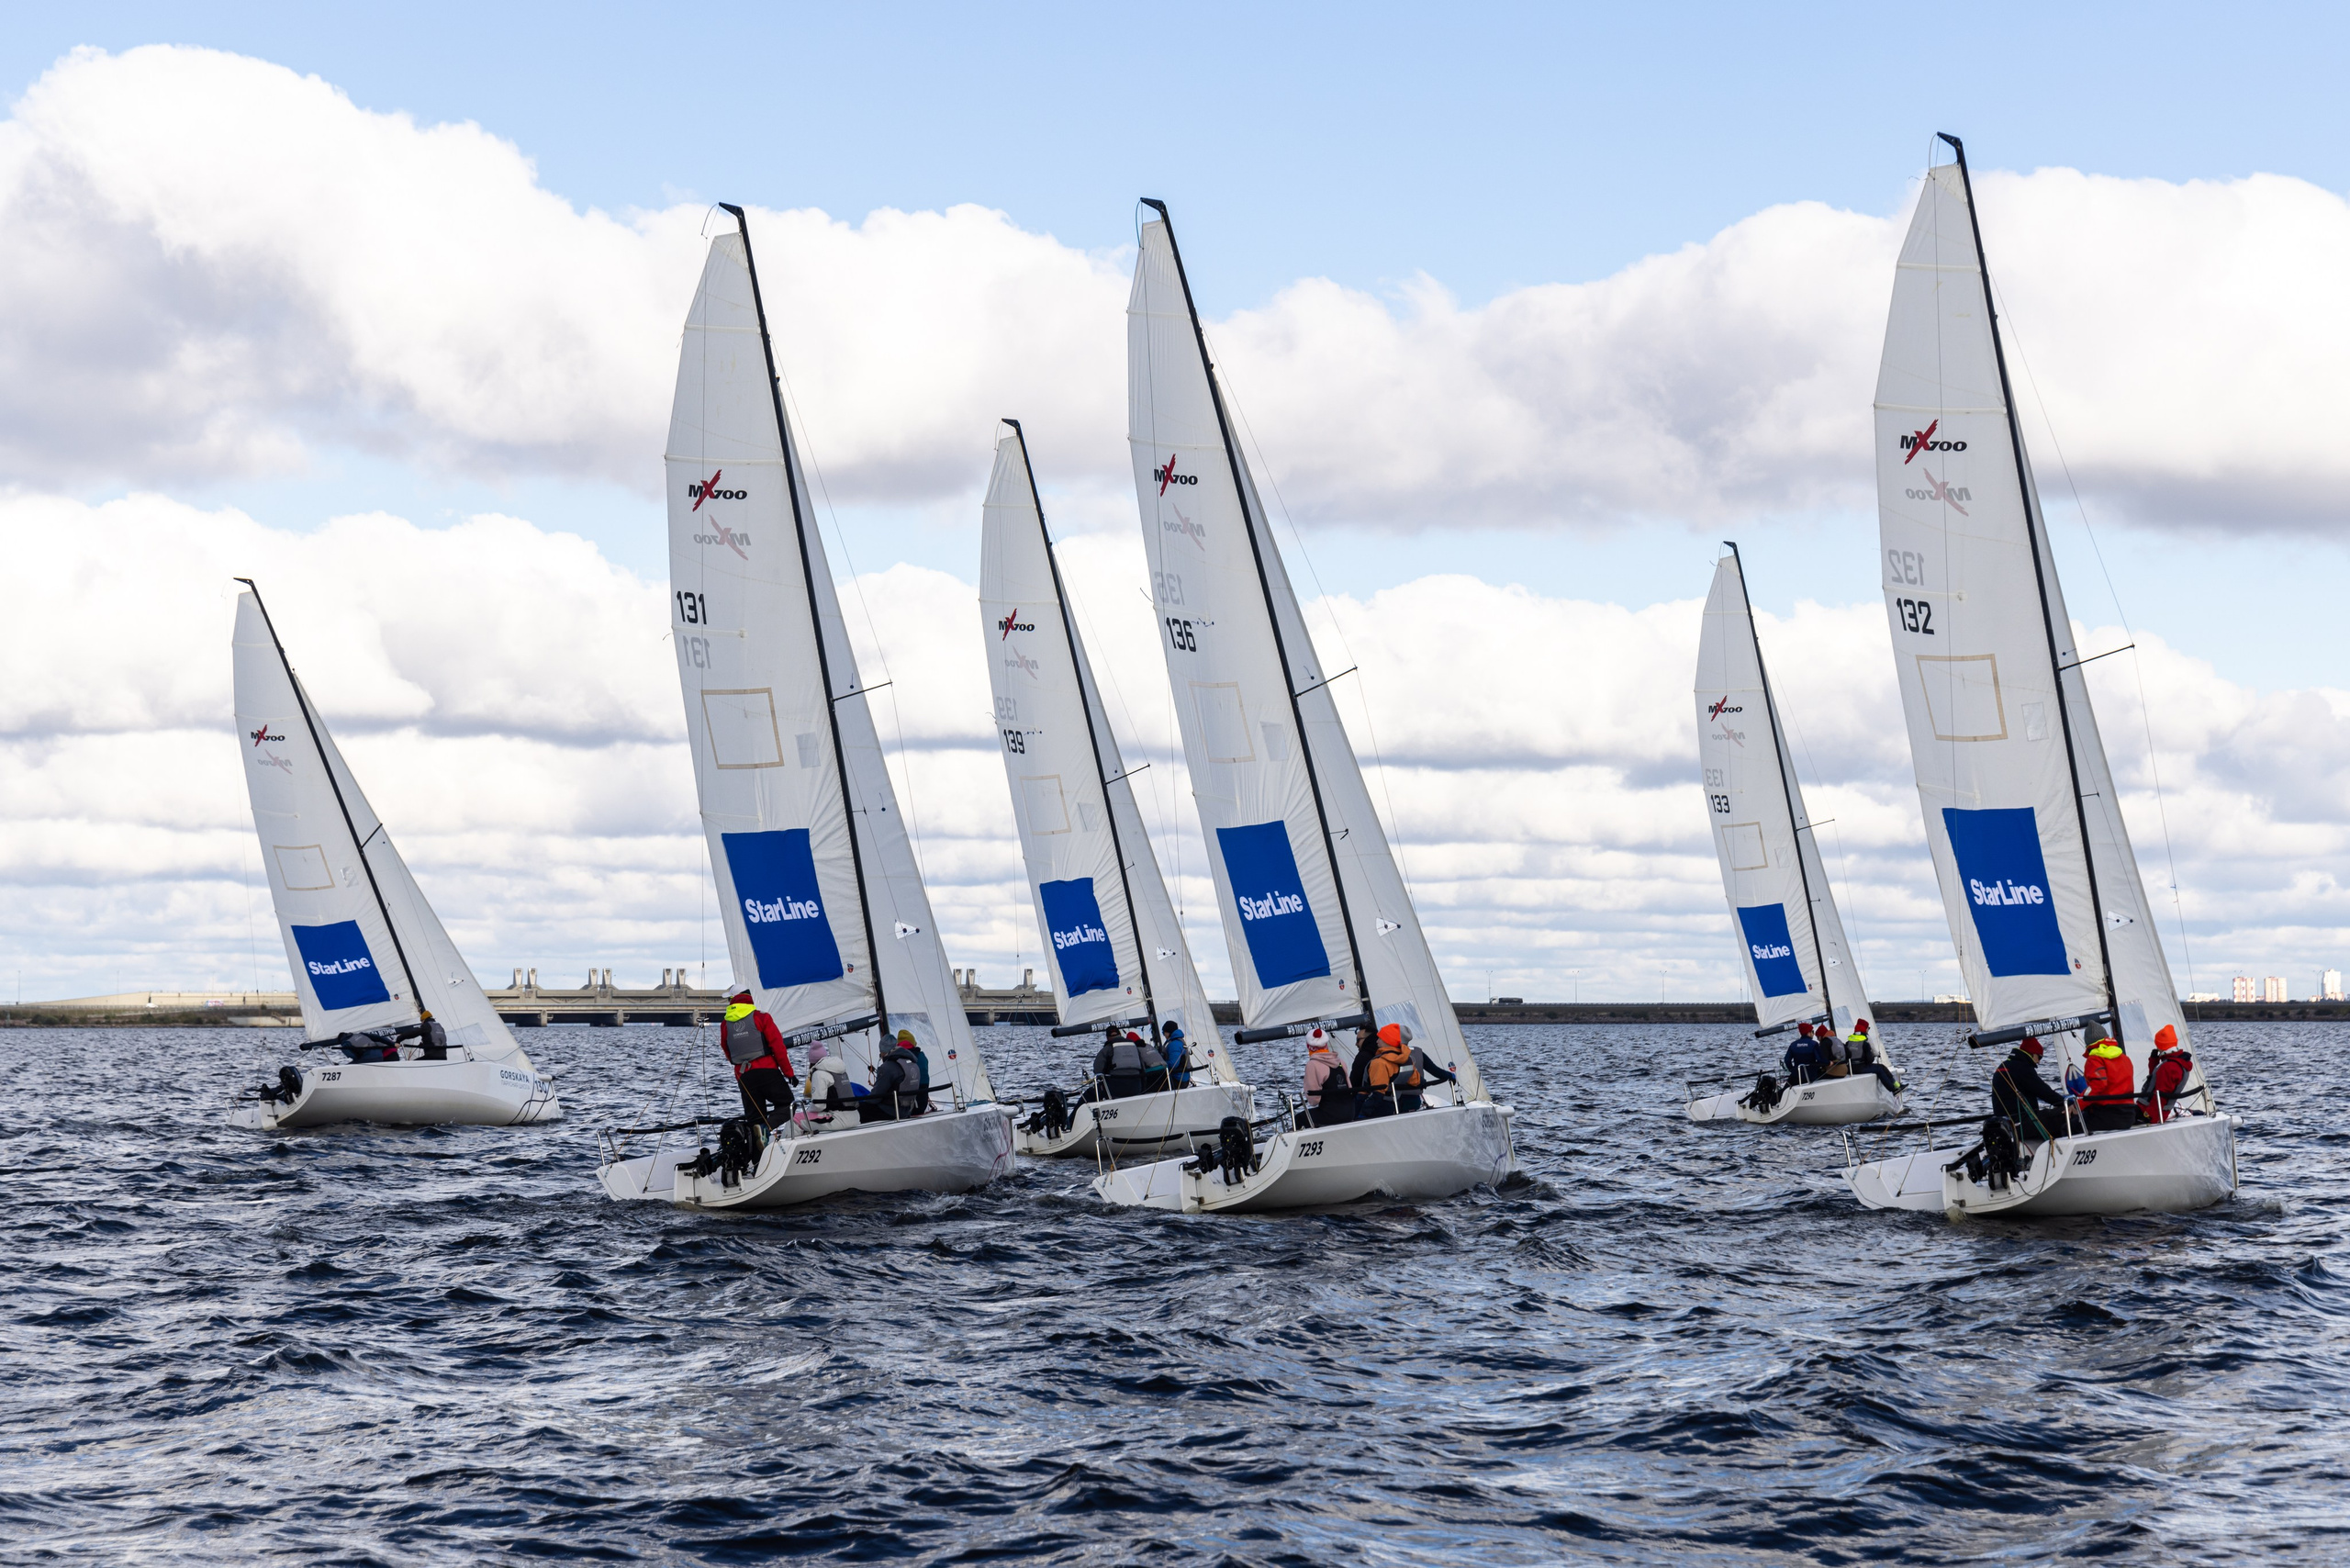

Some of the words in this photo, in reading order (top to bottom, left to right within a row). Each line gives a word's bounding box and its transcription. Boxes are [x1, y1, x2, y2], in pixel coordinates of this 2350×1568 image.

[1900, 419, 1967, 465] MX700
[1154, 454, 1198, 498] MX700
[688, 469, 747, 512] MX700
[677, 590, 707, 625] 131
[1897, 597, 1934, 635] 132
[998, 608, 1035, 642] MX700
[1166, 617, 1196, 653] 136
[1707, 695, 1743, 722] MX700
[251, 724, 285, 747] MX700
[1003, 728, 1025, 755] 139
[1710, 794, 1730, 813] 133
[1239, 890, 1304, 921] StarLine
[1970, 879, 2044, 906] StarLine
[744, 896, 820, 924] StarLine
[1053, 924, 1106, 950] StarLine
[1751, 944, 1791, 959] StarLine
[308, 958, 371, 975] StarLine
[821, 1028, 828, 1039] ЗА
[828, 1023, 848, 1037] ВЕТРОМ
[321, 1071, 341, 1081] 7287
[500, 1070, 530, 1083] GORSKAYA
[534, 1080, 547, 1094] 130
[1101, 1108, 1119, 1120] 7296
[796, 1148, 822, 1164] 7292
[1298, 1140, 1325, 1158] 7293
[2073, 1148, 2098, 1165] 7289
